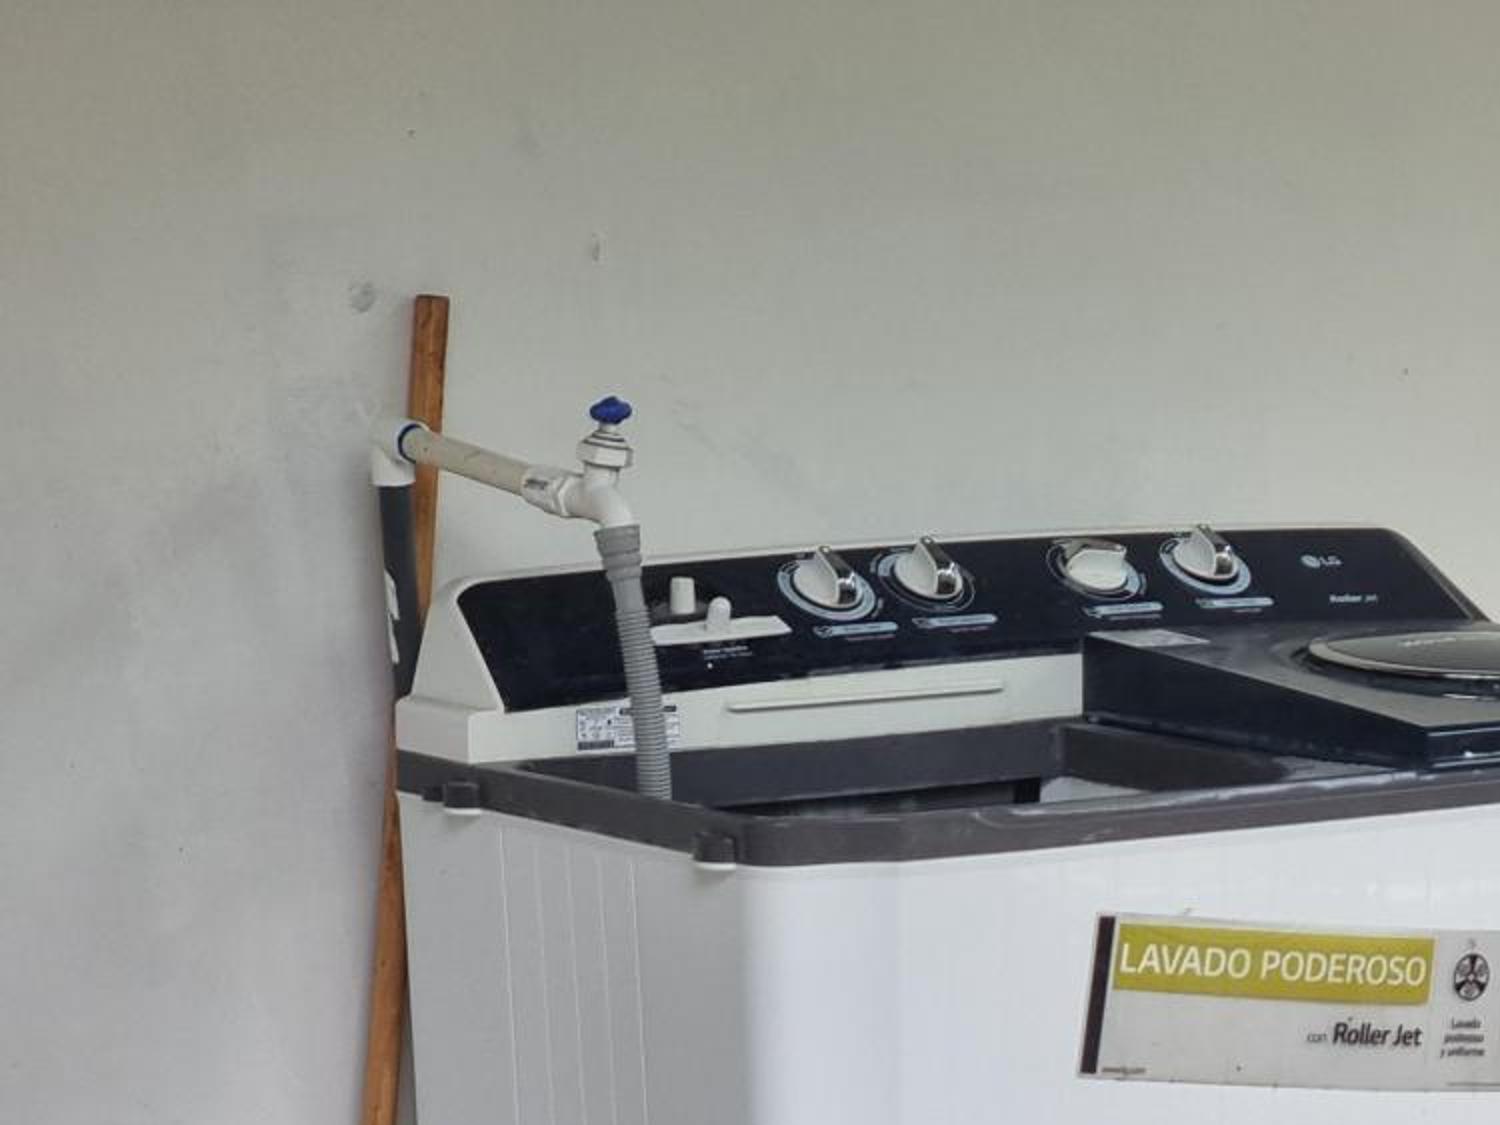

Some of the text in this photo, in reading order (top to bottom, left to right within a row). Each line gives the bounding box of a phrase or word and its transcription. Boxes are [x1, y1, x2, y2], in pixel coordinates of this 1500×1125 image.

[1119, 943, 1427, 987] LAVADO PODEROSO
[1306, 1021, 1423, 1046] con Roller Jet
